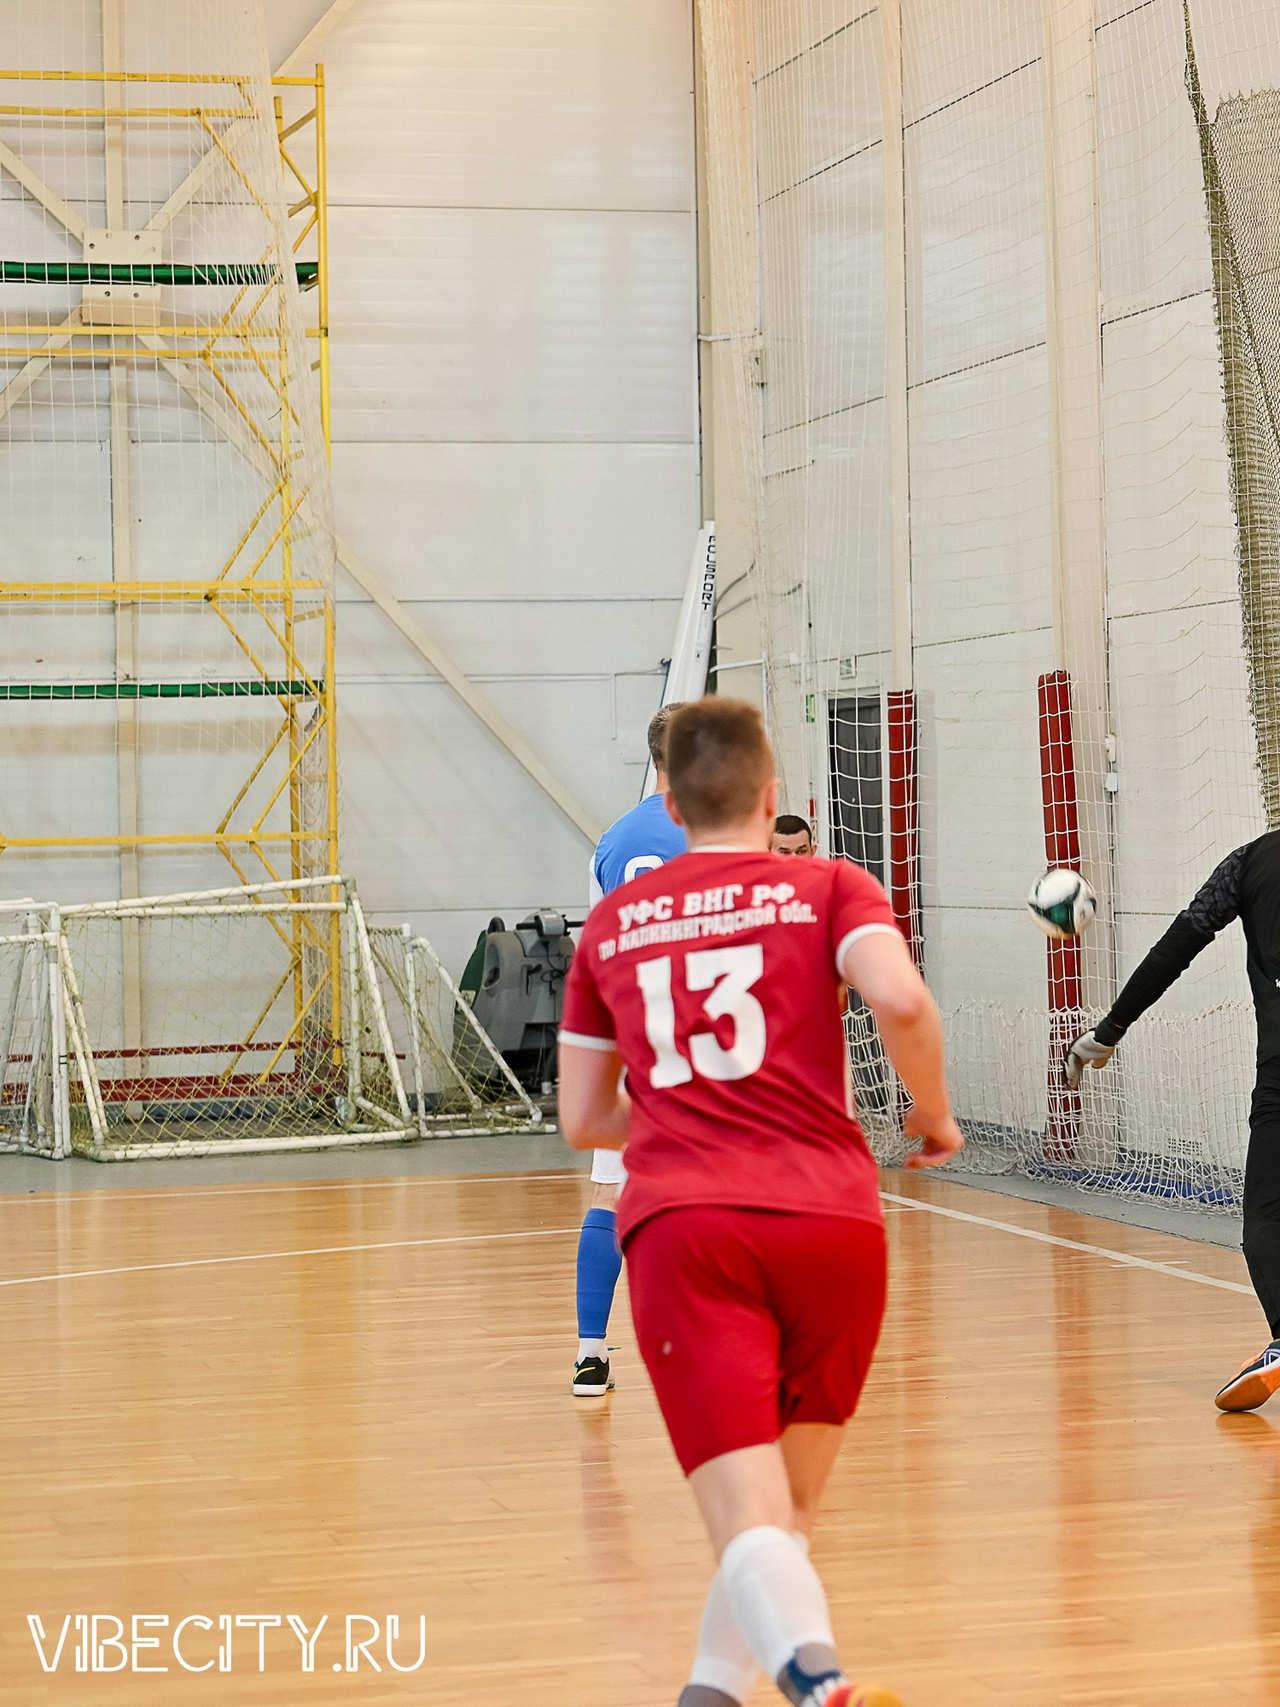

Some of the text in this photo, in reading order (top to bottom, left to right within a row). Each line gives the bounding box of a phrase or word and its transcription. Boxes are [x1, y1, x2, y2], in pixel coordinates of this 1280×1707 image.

[617, 882, 796, 932] УФС ВНГ РФ
[635, 943, 767, 1089] 13
